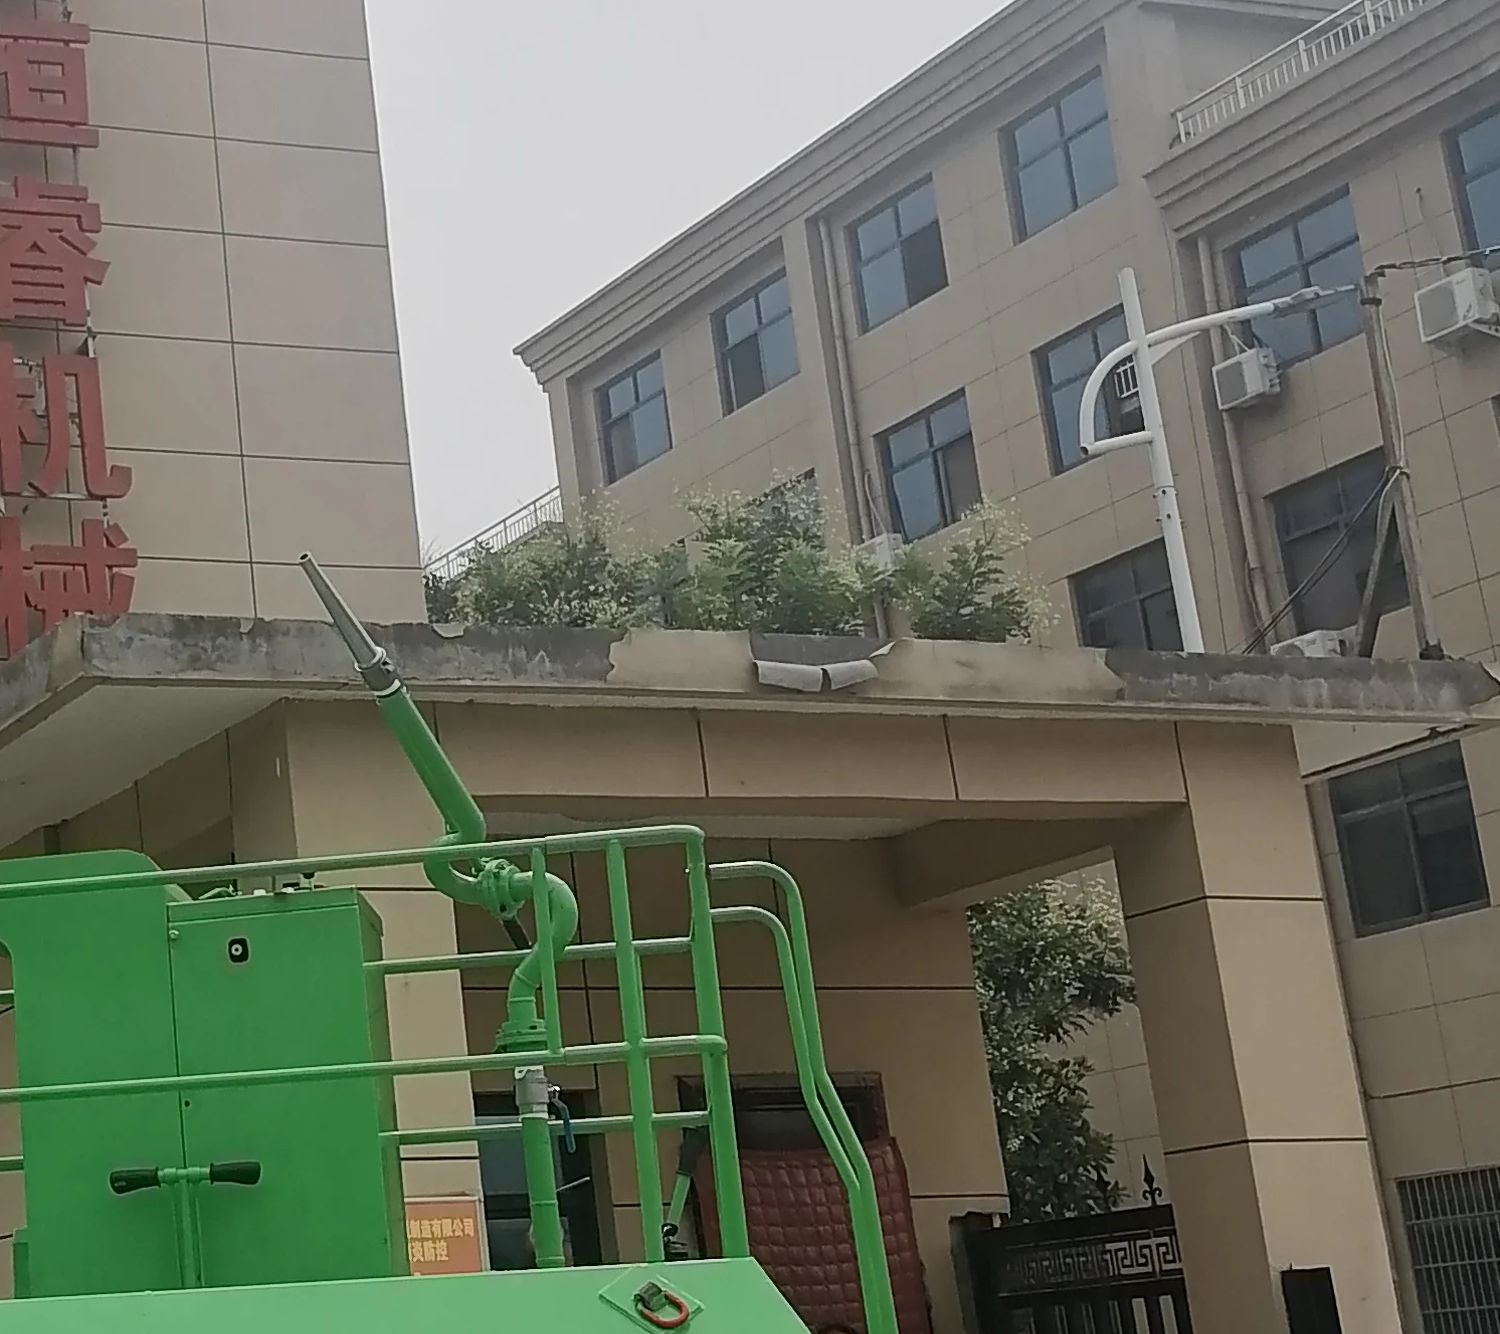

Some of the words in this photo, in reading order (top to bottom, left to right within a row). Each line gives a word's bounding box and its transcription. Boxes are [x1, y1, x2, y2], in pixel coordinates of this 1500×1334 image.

[406, 1218, 475, 1239] 制造有限公司
